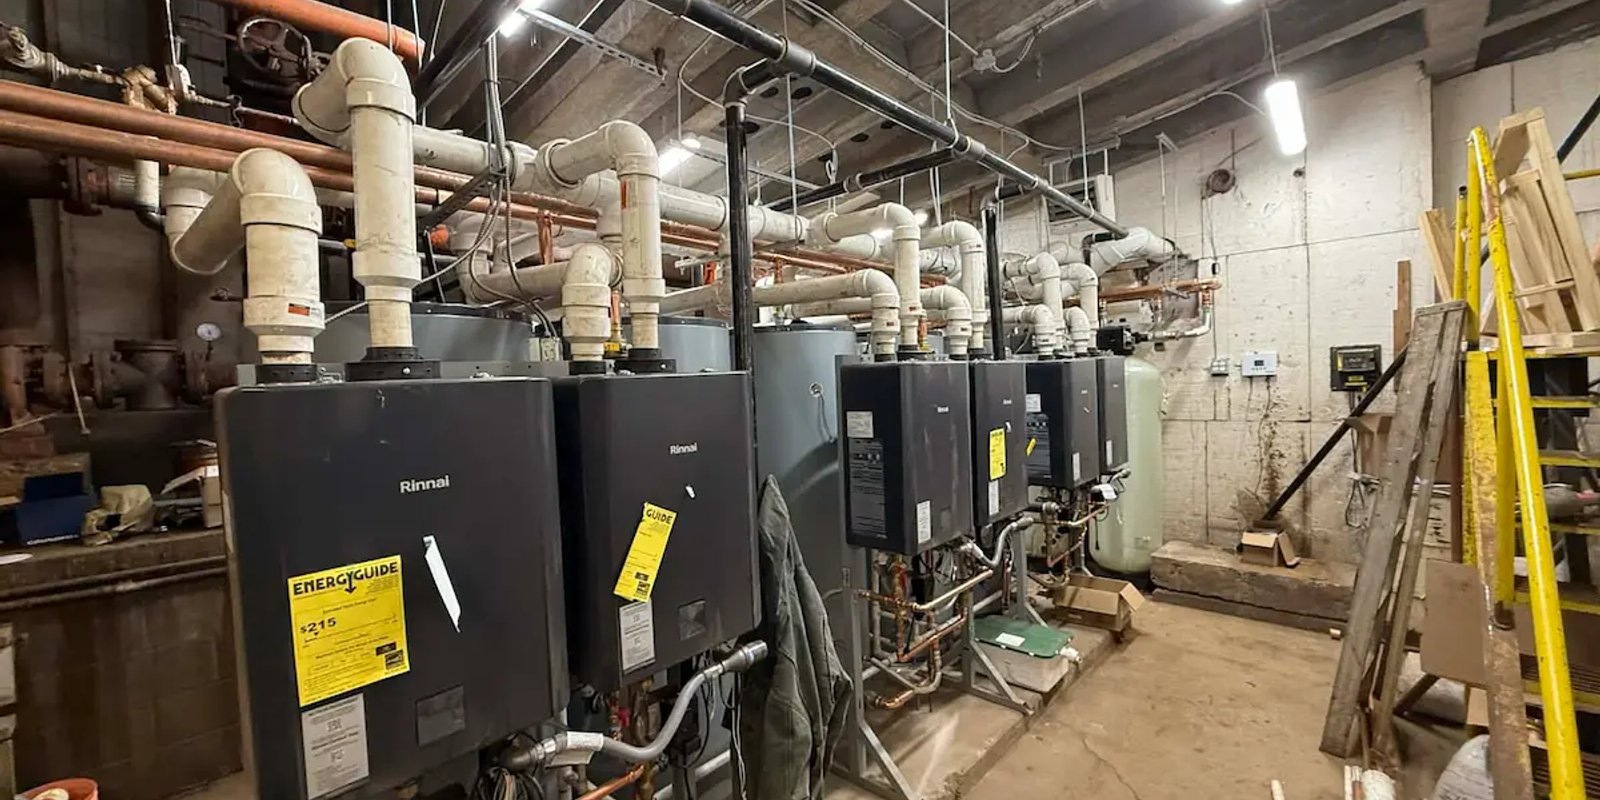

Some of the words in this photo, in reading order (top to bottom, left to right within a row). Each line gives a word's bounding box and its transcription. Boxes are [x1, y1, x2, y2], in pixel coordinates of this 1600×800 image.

[670, 442, 698, 454] Rinnai
[400, 475, 450, 493] Rinnai
[646, 509, 673, 525] GUIDE
[293, 561, 398, 595] ENERGYGUIDE
[300, 617, 336, 634] $215
